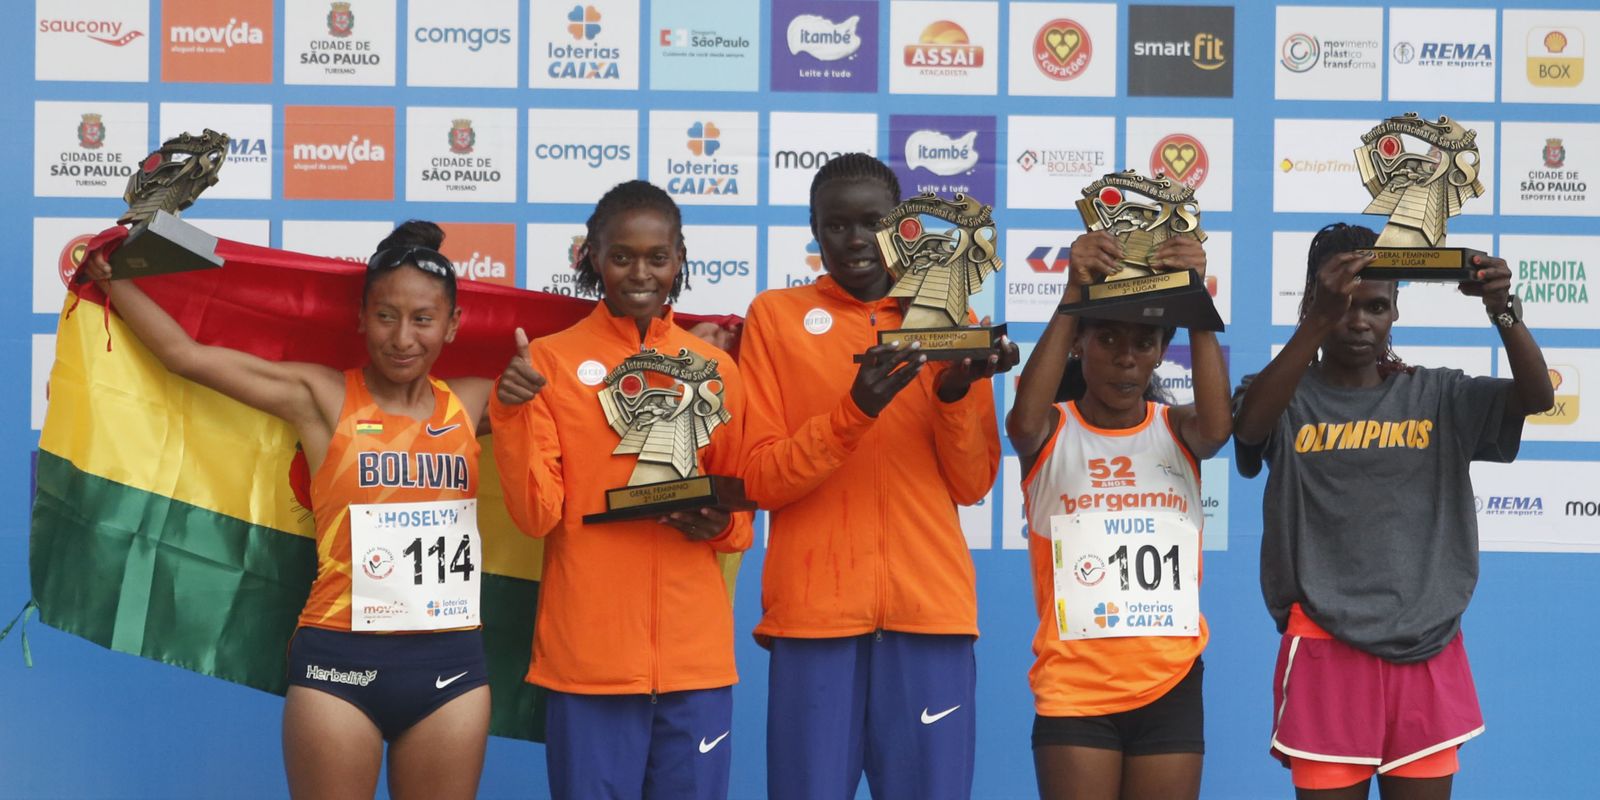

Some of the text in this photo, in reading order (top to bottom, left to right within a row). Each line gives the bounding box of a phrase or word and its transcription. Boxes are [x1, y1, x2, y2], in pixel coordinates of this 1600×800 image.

[40, 19, 123, 35] saucony
[171, 17, 264, 48] movida
[691, 36, 750, 48] SãoPaulo
[800, 29, 851, 45] itambé
[1324, 40, 1378, 48] movimento
[310, 41, 371, 51] CIDADE DE
[548, 43, 620, 60] loterias
[1134, 32, 1224, 60] smart fit
[1420, 43, 1492, 60] REMA
[300, 51, 380, 65] SÃO PAULO
[1324, 50, 1362, 60] plástico
[548, 61, 620, 79] CAIXA
[1037, 52, 1087, 77] 3 corações
[1324, 60, 1377, 69] transforma
[1539, 64, 1570, 79] BOX
[800, 69, 851, 78] Leite é tudo
[919, 69, 968, 77] ATACADISTA
[1363, 123, 1478, 150] Corrida Internacional de São Silvestre
[228, 138, 268, 156] MA
[293, 135, 385, 165] movida
[918, 144, 969, 160] itambé
[60, 153, 122, 163] CIDADE DE
[227, 156, 268, 164] sporte
[431, 157, 492, 168] CIDADE DE
[1041, 151, 1105, 166] INVENTE
[50, 163, 132, 178] SÃO PAULO
[667, 158, 739, 175] loterias
[1047, 162, 1093, 173] BOLSAS
[421, 168, 501, 182] SÃO PAULO
[1528, 171, 1579, 180] CIDADE DE
[667, 177, 739, 195] CAIXA
[917, 184, 969, 193] Leite é tudo
[1105, 177, 1149, 193] Internacional
[1149, 187, 1158, 197] de
[1158, 190, 1170, 201] São
[1170, 184, 1195, 203] Silvestre
[1520, 180, 1587, 192] SÃO PAULO
[883, 203, 993, 227] Corrida Internacional de São Silvestre
[1378, 251, 1440, 259] GERAL FEMININO
[453, 252, 506, 280] vida
[1401, 259, 1426, 267] LUGAR
[686, 260, 750, 284] mgas
[1519, 261, 1587, 281] BENDITA
[543, 284, 571, 297] SÃO
[1009, 283, 1034, 295] EXPO
[1107, 276, 1170, 290] GERAL FEMININO
[1132, 284, 1157, 293] LUGAR
[1515, 281, 1589, 303] CÂNFORA
[904, 333, 968, 342] GERAL FEMININO
[603, 364, 628, 385] Corrida
[625, 360, 671, 374] Internacional
[671, 367, 680, 377] de
[680, 368, 692, 380] São
[692, 358, 719, 381] Silvestre
[1536, 402, 1567, 416] OX
[1295, 419, 1433, 453] OLYMPIKUS
[358, 451, 469, 491] BOLIVIA
[1088, 456, 1136, 480] 52
[630, 483, 689, 498] GERAL FEMININO
[1101, 480, 1127, 488] ANOS
[653, 492, 677, 502] LUGAR
[1060, 488, 1188, 514] bergamini
[1486, 496, 1543, 510] REMA
[1104, 518, 1156, 535] WUDE
[403, 534, 475, 586] 114
[1108, 544, 1181, 591] 101
[443, 599, 468, 608] loterias
[1125, 601, 1174, 612] loterias
[443, 607, 468, 616] CAIXA
[1126, 615, 1174, 627] CAIXA
[306, 665, 369, 687] Herbalife
